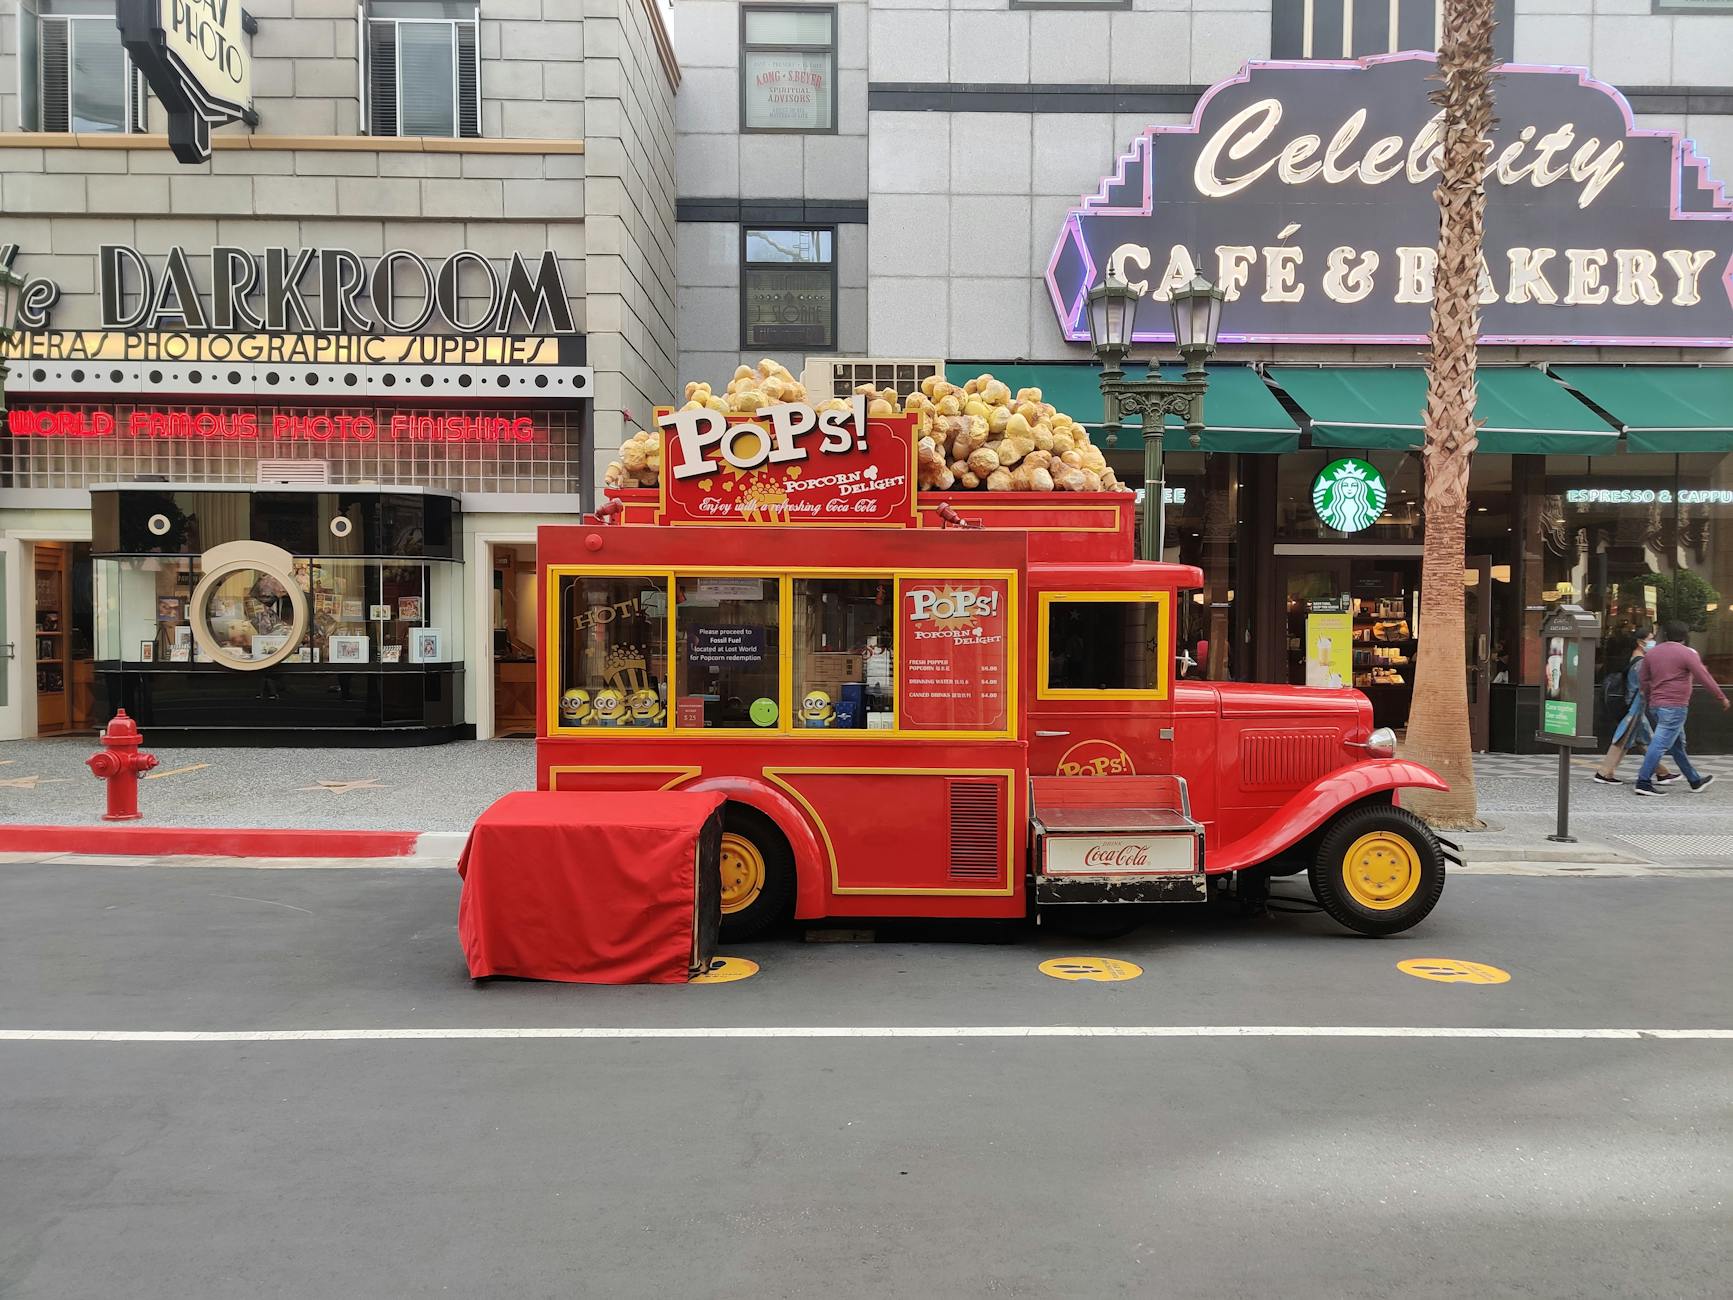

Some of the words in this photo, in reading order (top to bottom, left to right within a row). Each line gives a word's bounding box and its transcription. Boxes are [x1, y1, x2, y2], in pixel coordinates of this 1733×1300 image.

[172, 0, 243, 84] PHOTO
[768, 94, 811, 103] ADVISORS
[1194, 98, 1625, 209] Celebity
[1106, 224, 1304, 302] CAFÉ
[1323, 246, 1380, 304] &
[100, 244, 577, 334] DARKROOM
[124, 332, 386, 362] PHOTOGRAPHIC
[398, 336, 546, 364] SUPPLIES
[9, 411, 114, 436] WORLD
[273, 415, 376, 441] PHOTO
[783, 470, 861, 494] POPCORN
[839, 475, 905, 497] DELIGHT
[699, 497, 732, 515] Enjoy
[735, 499, 758, 512] with
[761, 503, 768, 512] a
[771, 498, 822, 515] refreshing
[826, 497, 878, 513] Coca-Cola
[1566, 489, 1655, 503] ESPRESSO
[1658, 489, 1673, 503] &
[572, 597, 642, 631] HOT!
[710, 636, 727, 644] Fossil
[720, 628, 744, 636] proceed
[913, 629, 970, 640] POPCORN
[954, 635, 1002, 646] DELIGHT
[694, 645, 716, 653] located
[700, 655, 725, 663] Popcorn
[726, 654, 762, 663] redemption
